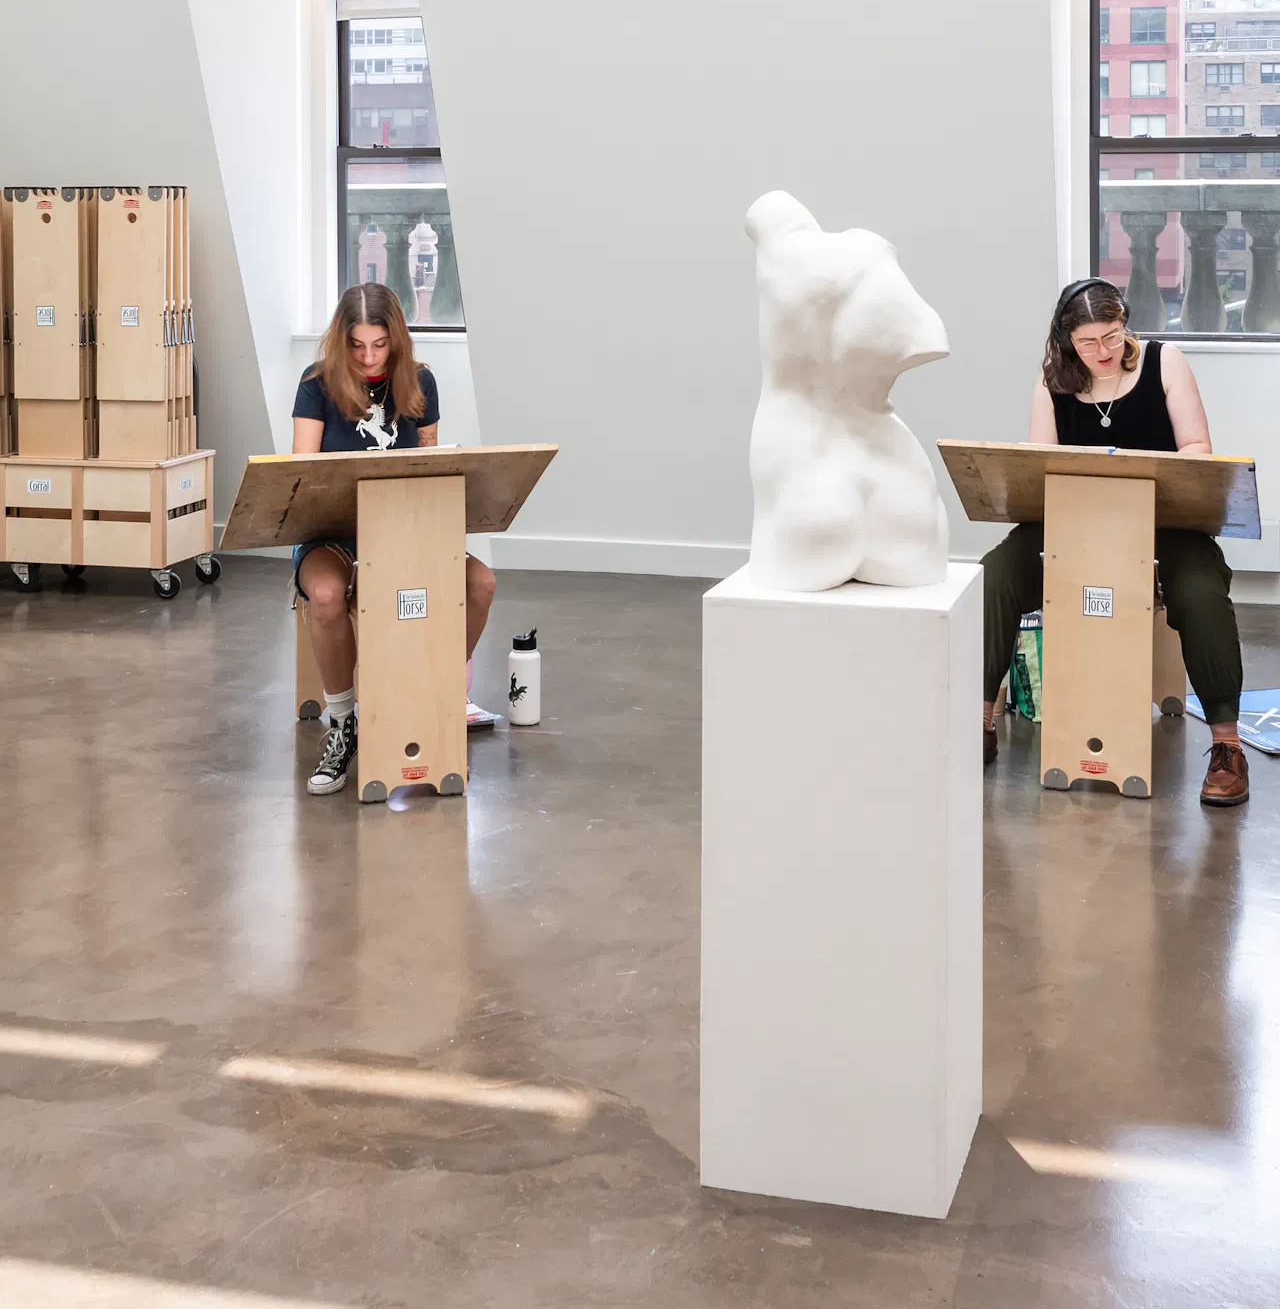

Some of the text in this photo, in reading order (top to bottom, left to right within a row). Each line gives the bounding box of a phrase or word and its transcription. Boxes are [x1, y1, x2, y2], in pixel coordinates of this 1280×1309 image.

[29, 479, 50, 492] Corral
[399, 592, 425, 617] Horse
[1084, 588, 1111, 613] Horse
